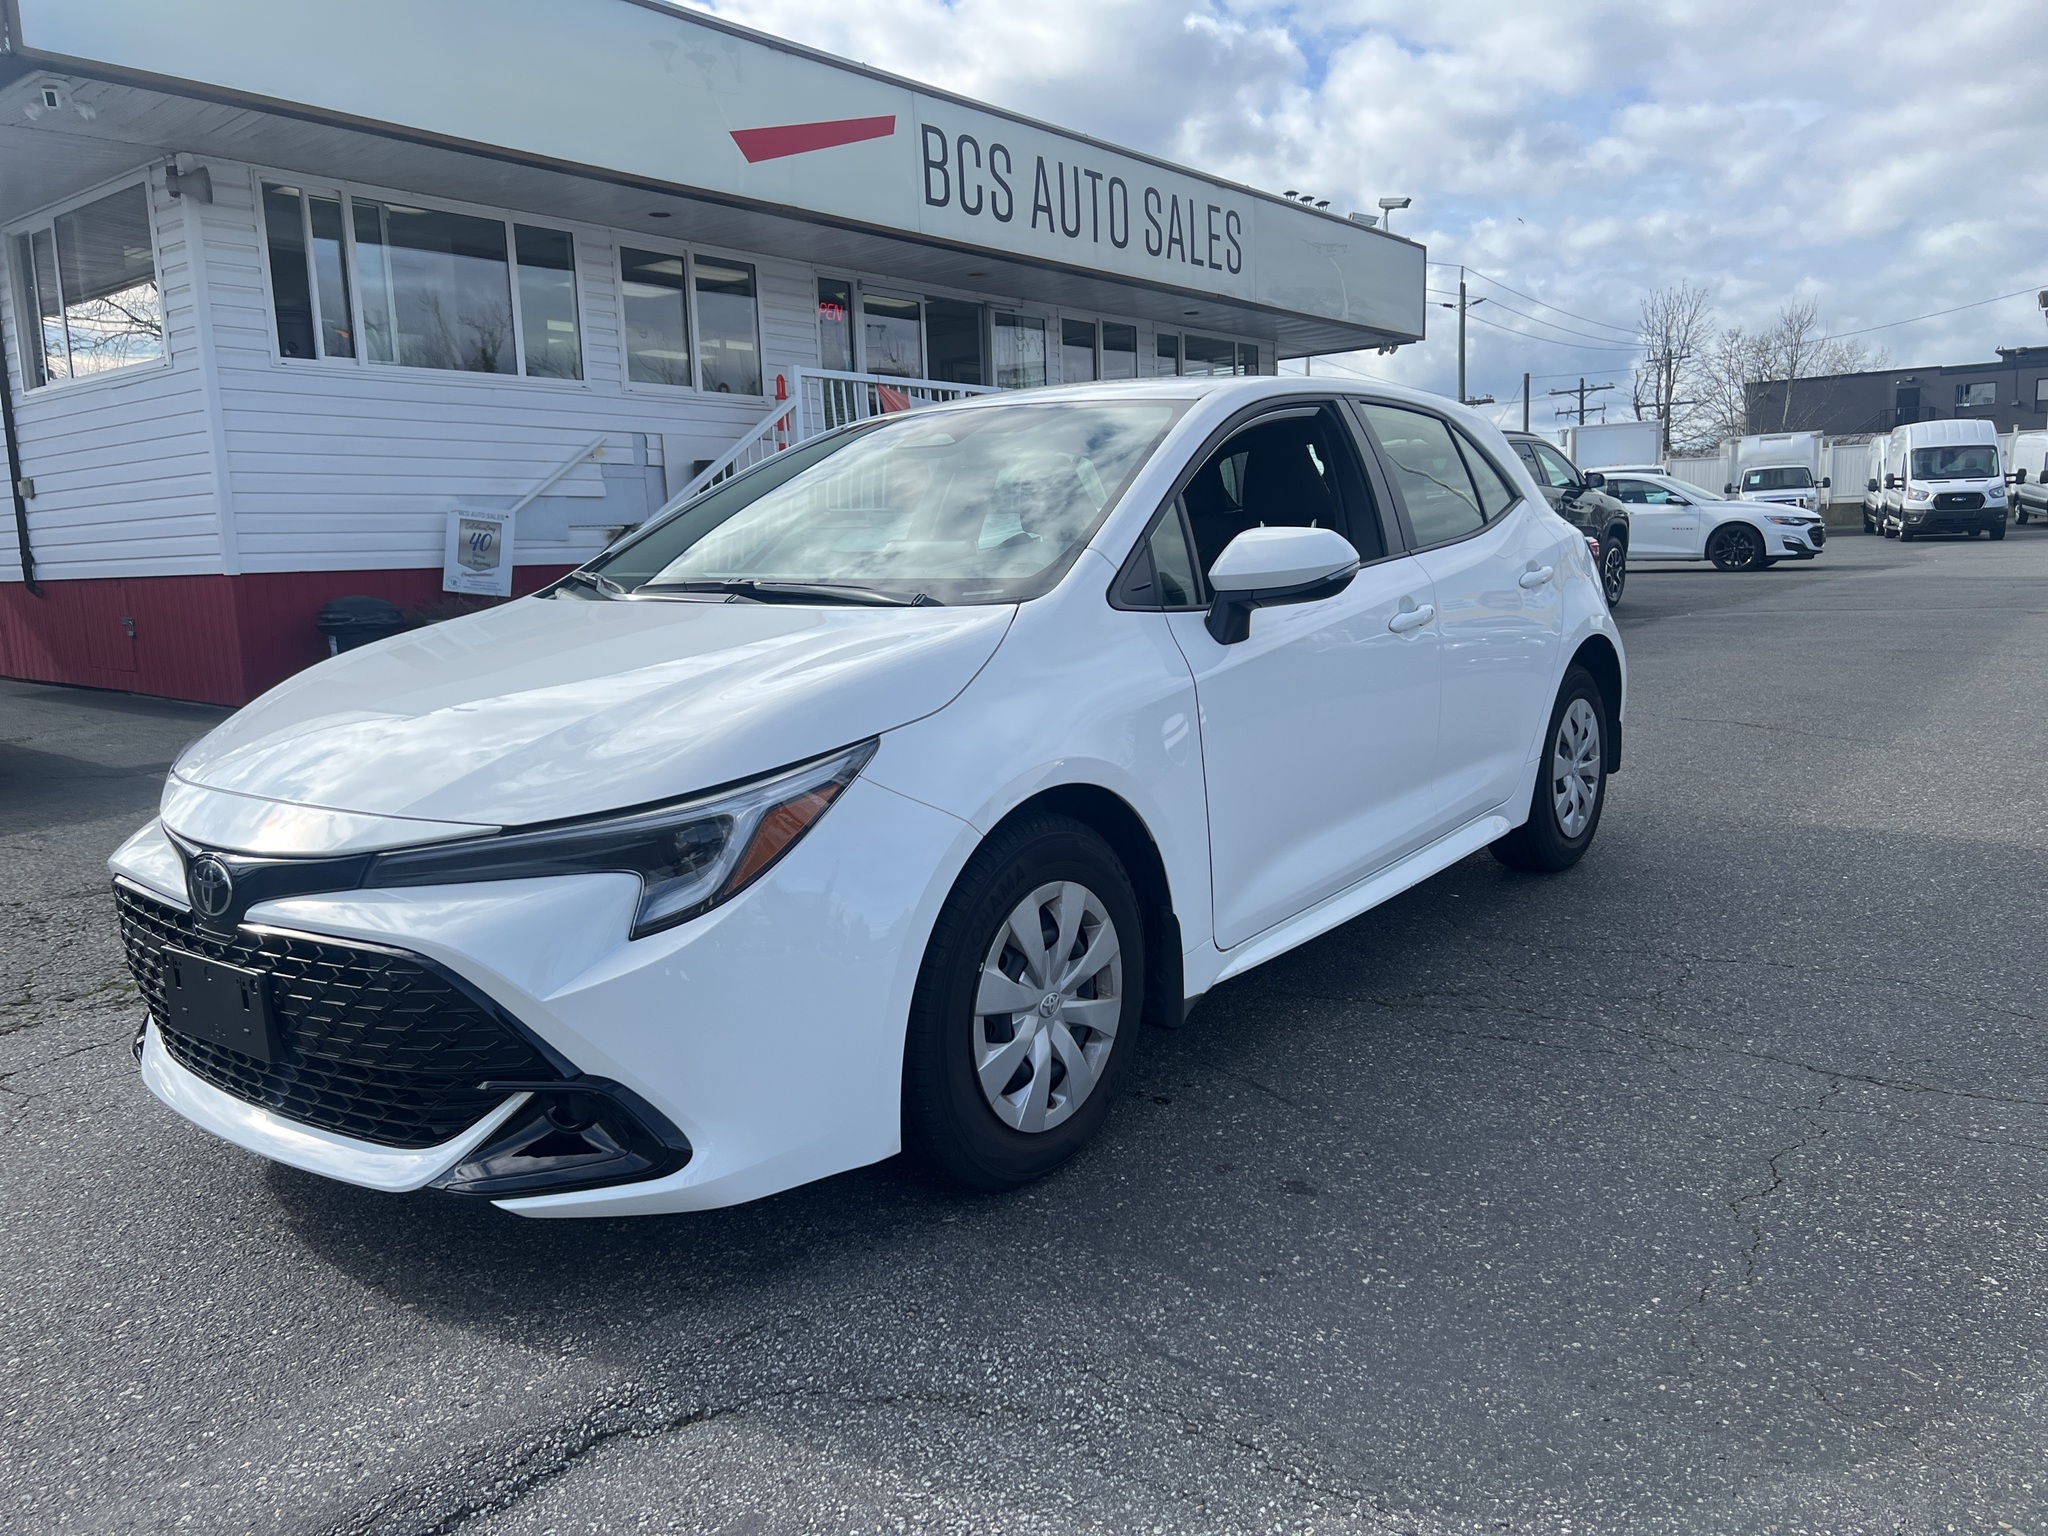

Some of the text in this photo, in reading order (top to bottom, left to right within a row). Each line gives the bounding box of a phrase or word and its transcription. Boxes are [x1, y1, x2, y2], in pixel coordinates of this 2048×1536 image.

[921, 123, 1242, 275] BCS AUTO SALES
[818, 302, 844, 321] PEN
[469, 532, 493, 552] 40
